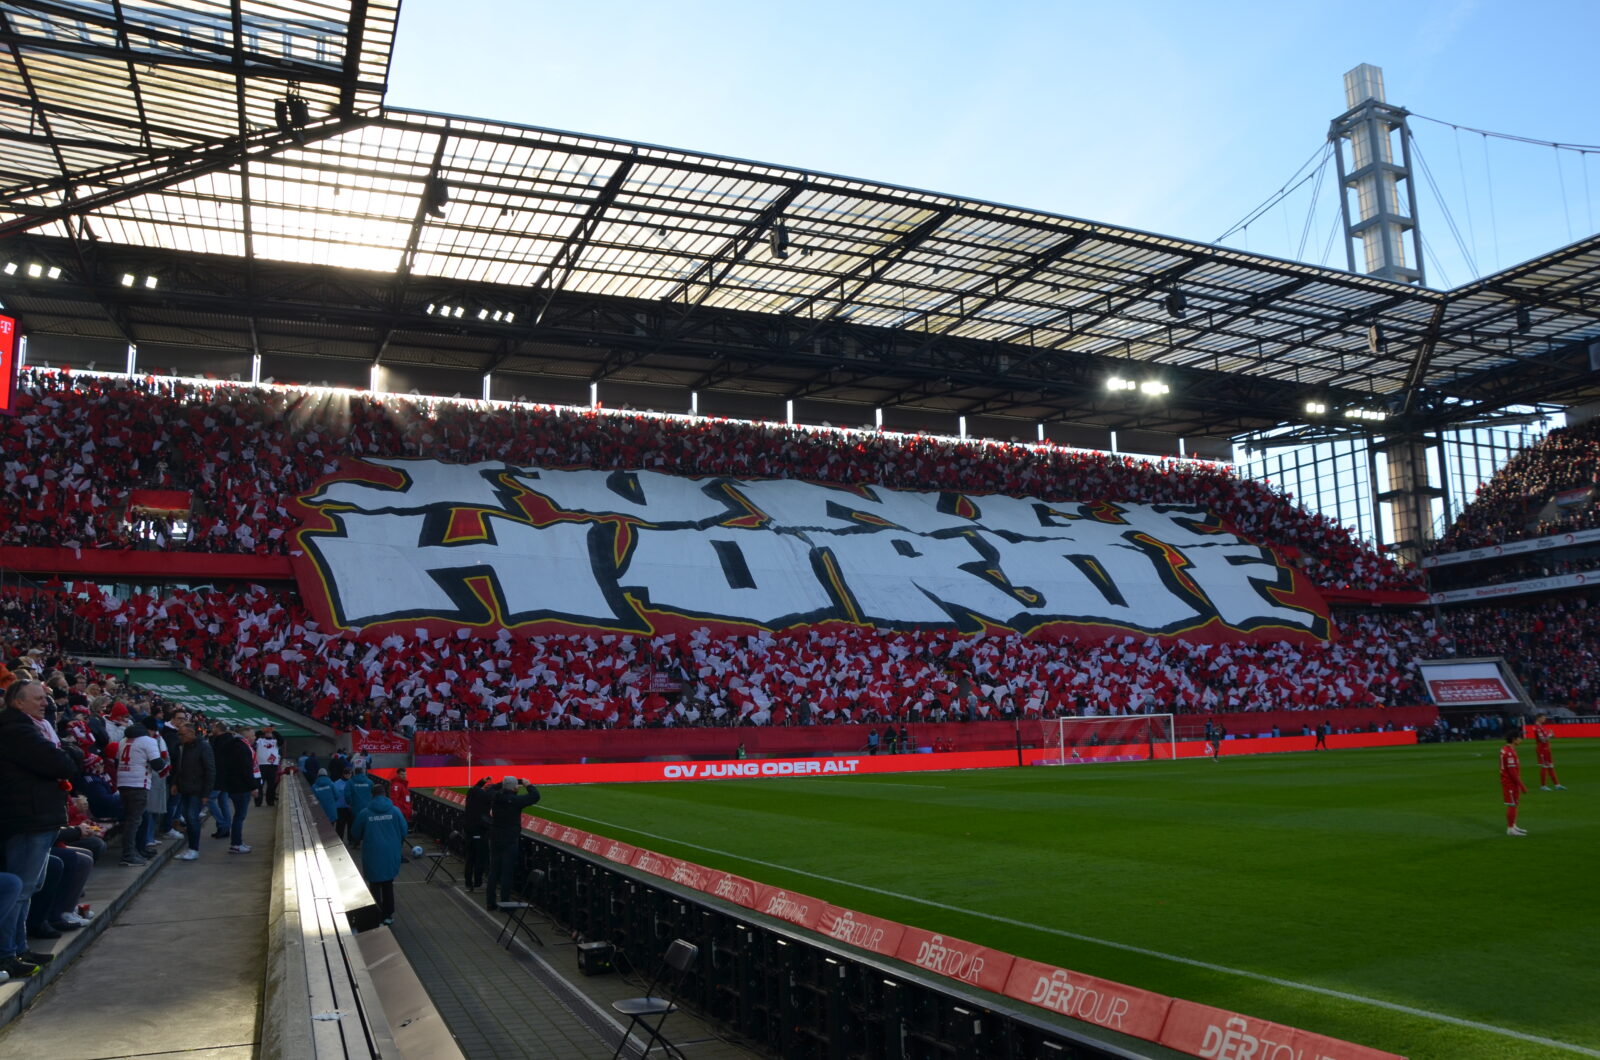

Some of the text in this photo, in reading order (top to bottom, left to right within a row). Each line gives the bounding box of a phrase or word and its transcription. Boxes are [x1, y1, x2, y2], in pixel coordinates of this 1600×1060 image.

[306, 509, 1326, 634] HORDE
[207, 717, 284, 726] EVK
[121, 744, 131, 765] 4
[664, 760, 859, 778] OV JUNG ODER ALT
[766, 896, 808, 922] DERTOUR
[830, 916, 884, 949] DERTOUR
[916, 941, 984, 983] DERTOUR
[1030, 976, 1129, 1028] DERTOUR
